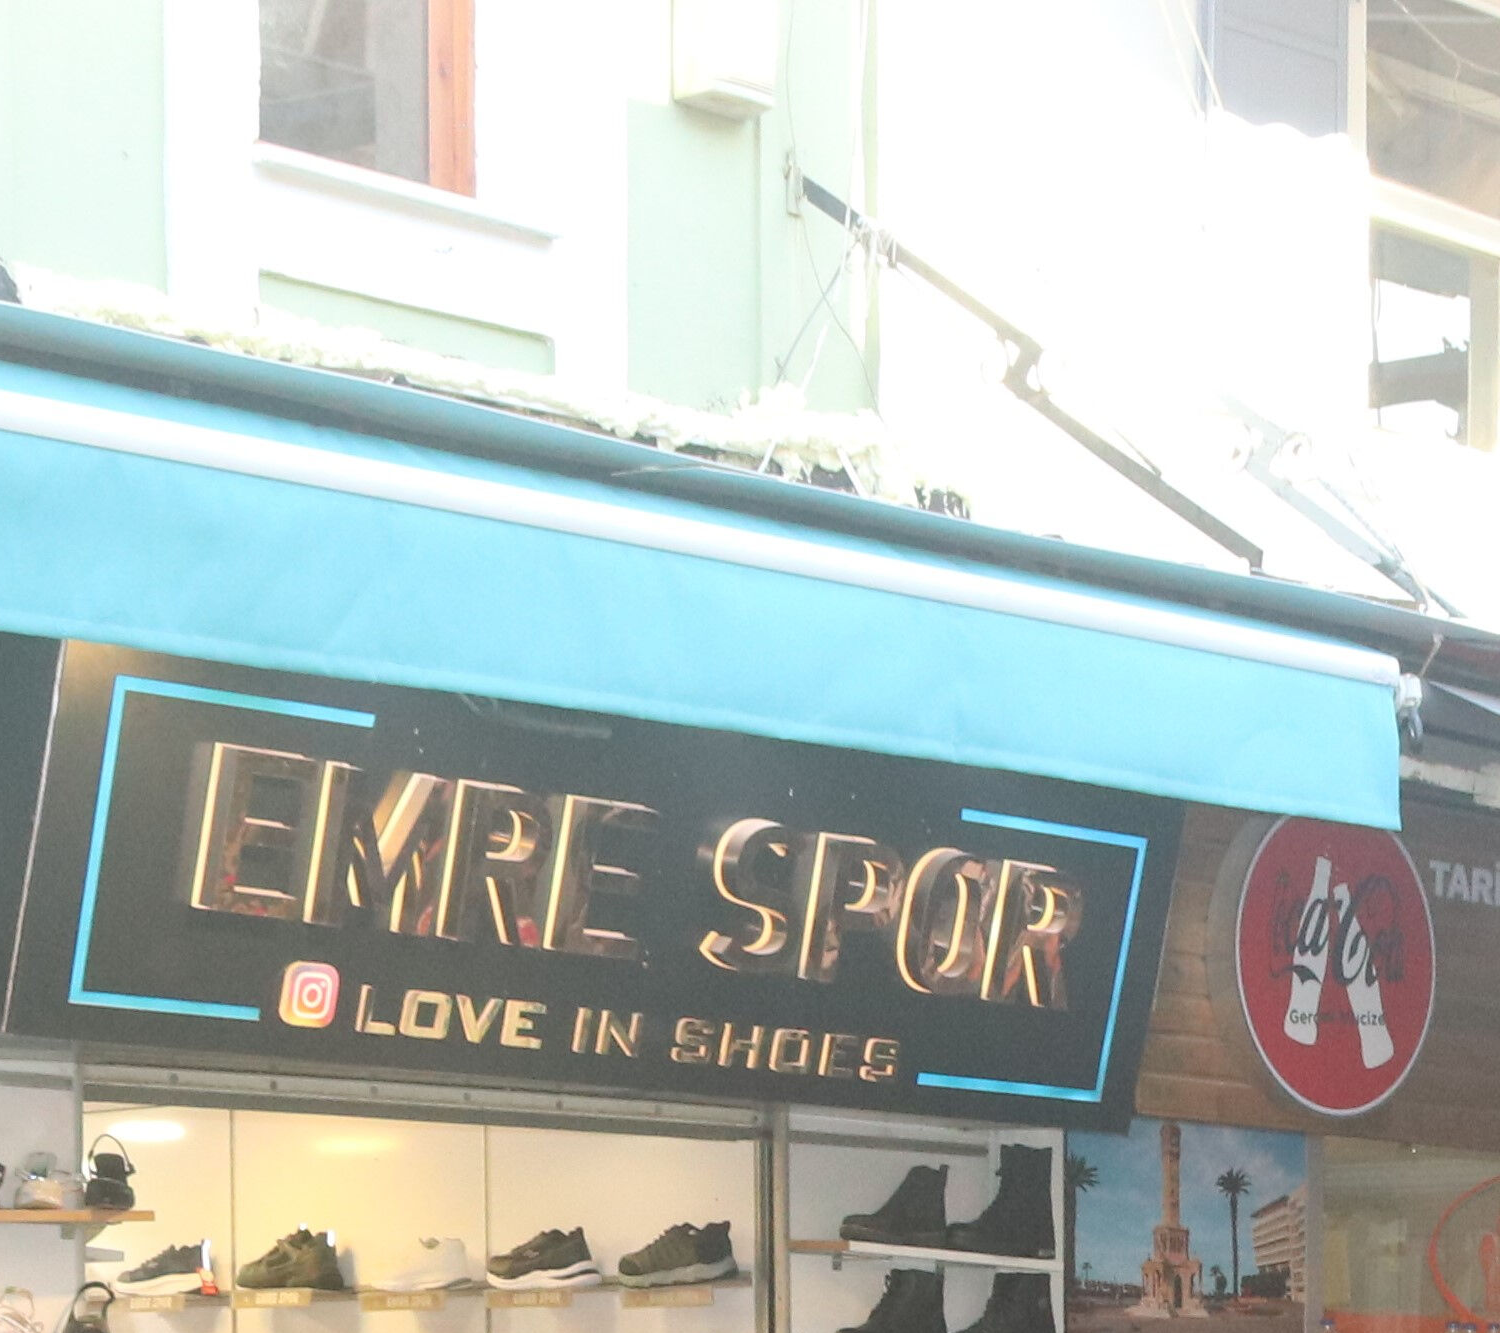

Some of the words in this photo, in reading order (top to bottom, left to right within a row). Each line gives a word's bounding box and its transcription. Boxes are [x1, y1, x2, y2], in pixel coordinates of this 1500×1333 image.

[188, 740, 660, 963] EMRE
[698, 815, 1082, 1010] SPOR
[353, 982, 544, 1050] LOVE
[572, 1006, 644, 1060] IN
[669, 1016, 901, 1084] SHOES
